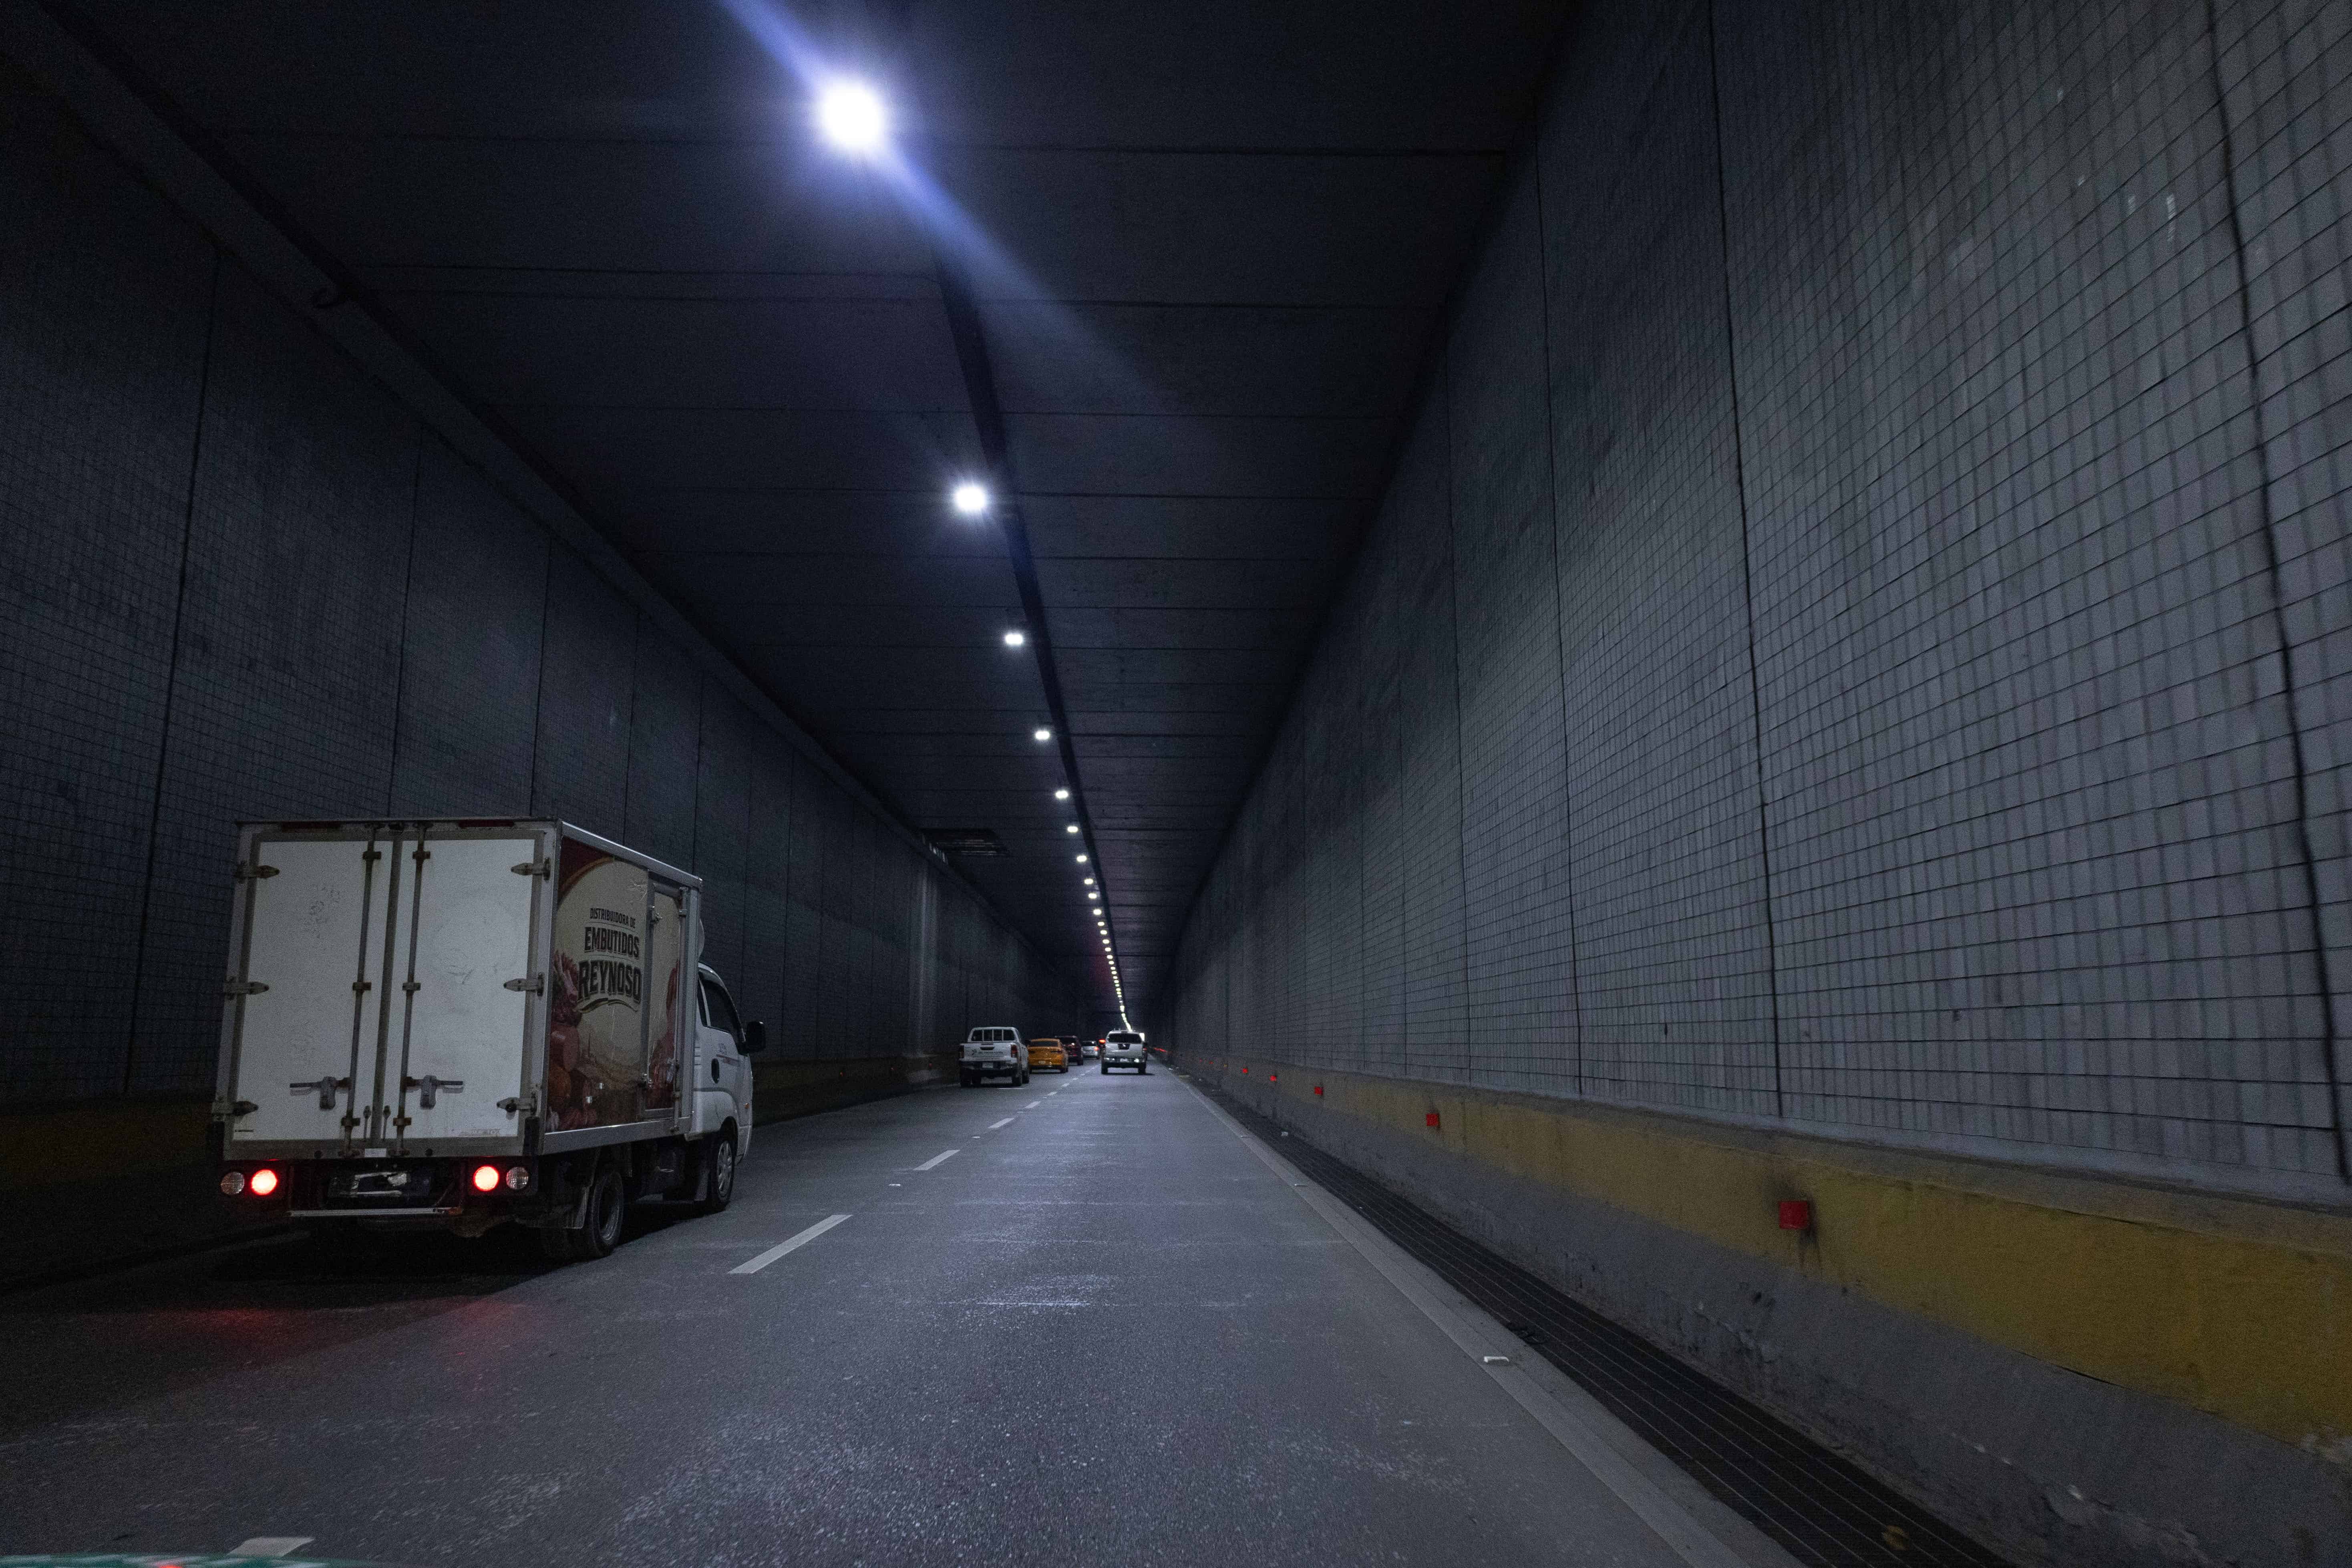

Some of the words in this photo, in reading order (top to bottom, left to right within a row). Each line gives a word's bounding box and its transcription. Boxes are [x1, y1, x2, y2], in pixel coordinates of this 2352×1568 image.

[590, 908, 629, 926] DISTRIBUIDORA
[630, 917, 636, 929] DE
[584, 926, 640, 959] EMBUTIDOS
[577, 960, 642, 1004] REYNOSO
